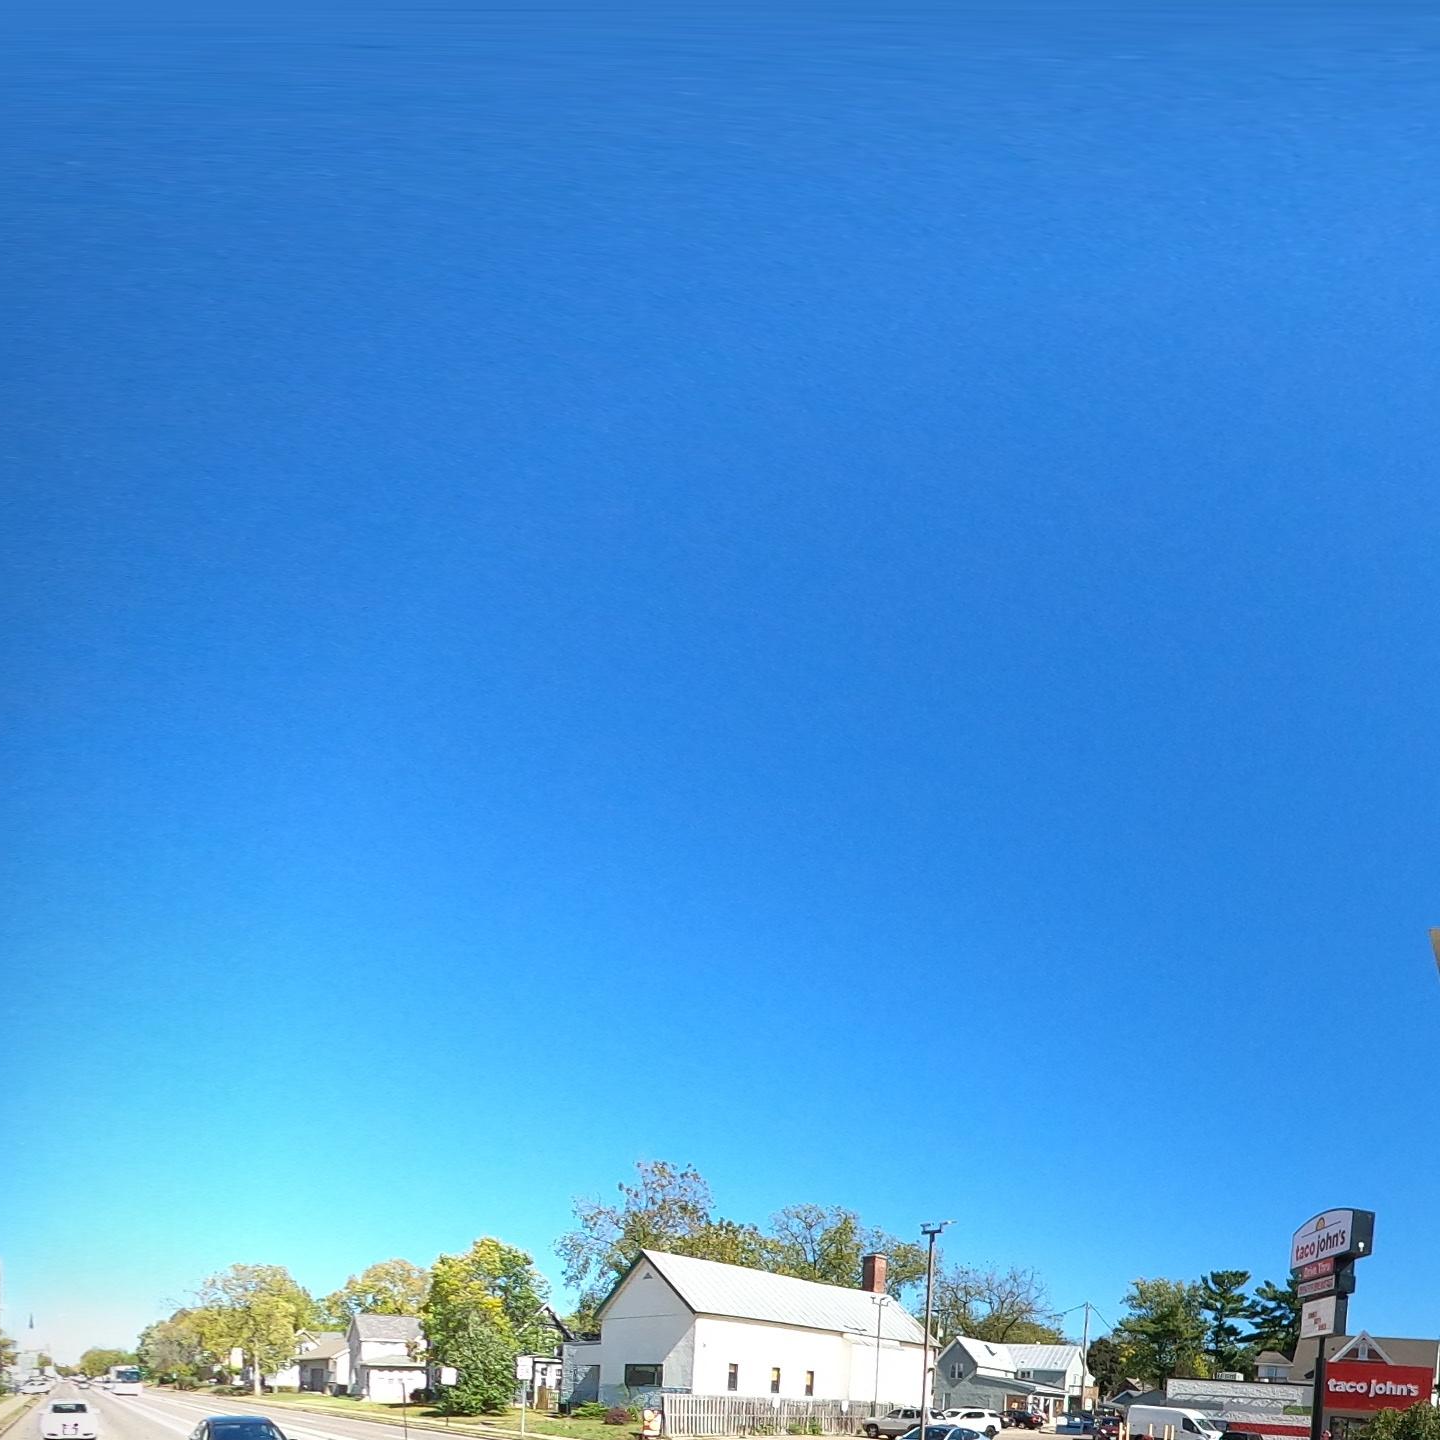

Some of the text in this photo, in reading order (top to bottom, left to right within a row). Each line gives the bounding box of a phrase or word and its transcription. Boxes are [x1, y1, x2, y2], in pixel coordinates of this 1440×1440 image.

[1295, 1230, 1346, 1262] taco john's
[1327, 1378, 1420, 1398] taco john's
